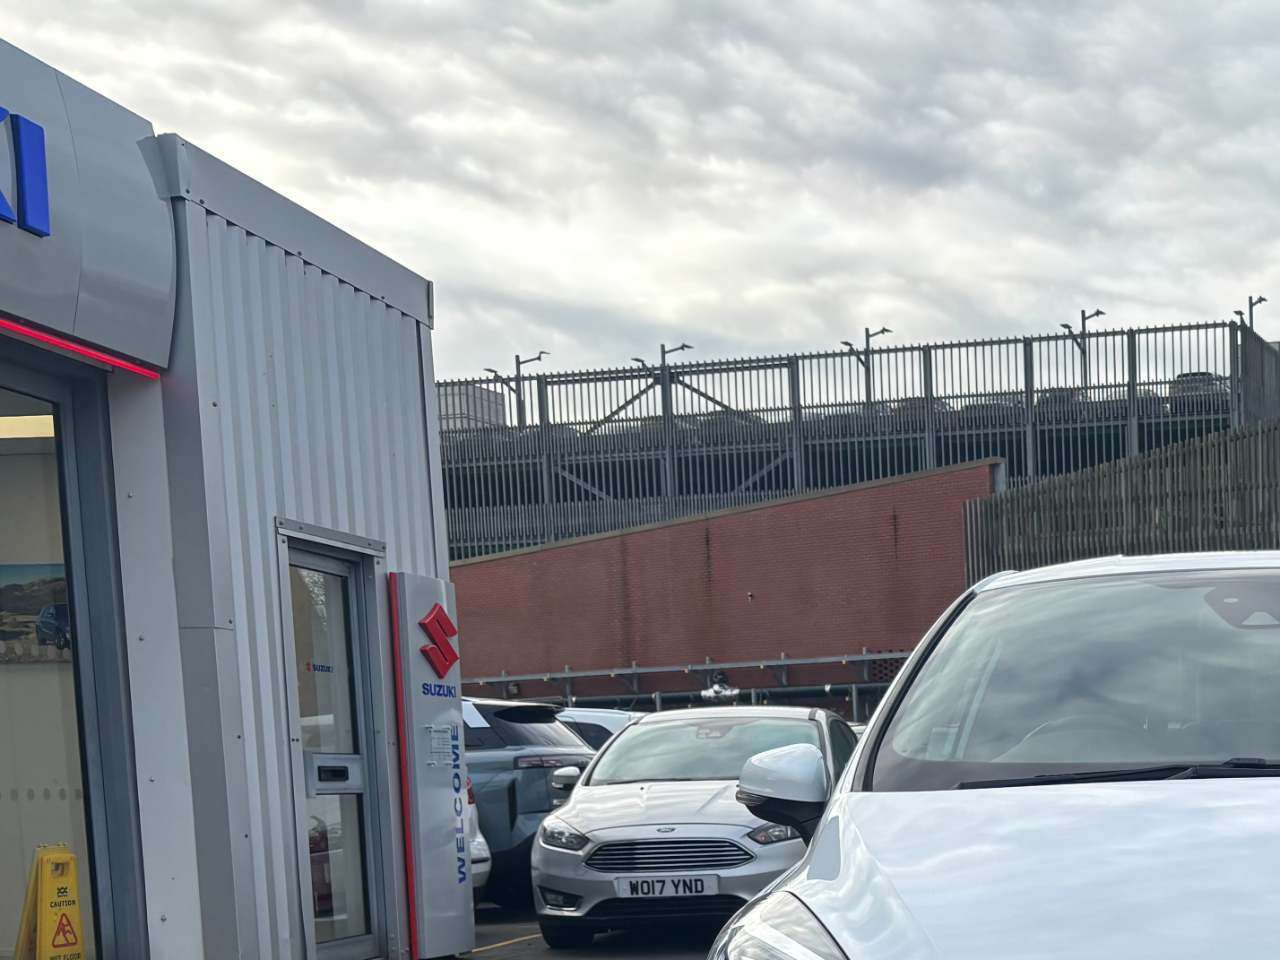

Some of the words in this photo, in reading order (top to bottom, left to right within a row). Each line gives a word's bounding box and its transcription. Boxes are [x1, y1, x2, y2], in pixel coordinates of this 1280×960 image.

[422, 683, 456, 698] SUZUKI
[451, 725, 467, 884] WELCOME
[629, 880, 666, 896] WO17
[671, 878, 705, 894] YND
[50, 900, 76, 908] CAUTION
